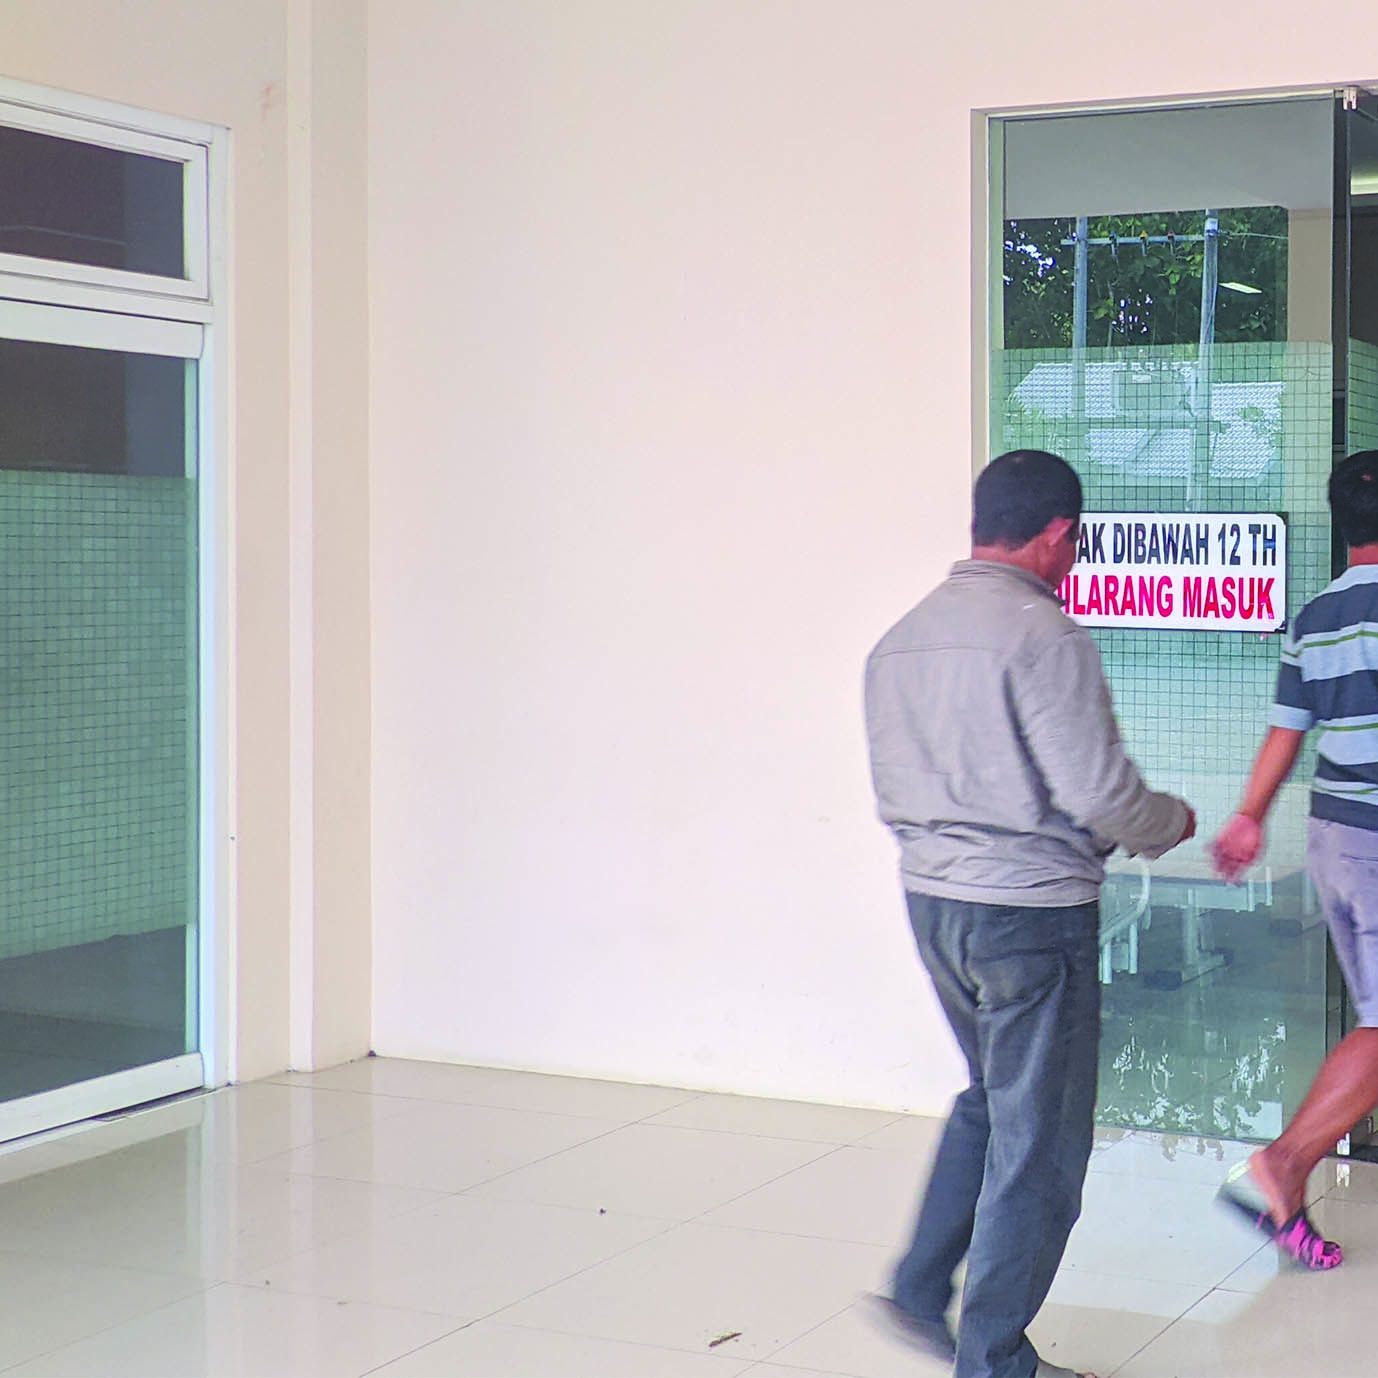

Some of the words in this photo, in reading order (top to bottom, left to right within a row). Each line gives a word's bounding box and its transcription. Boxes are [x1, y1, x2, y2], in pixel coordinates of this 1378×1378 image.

[1077, 523, 1106, 564] AK
[1113, 523, 1209, 565] DIBAWAH
[1218, 523, 1241, 566] 12
[1248, 524, 1277, 566] TH
[1058, 575, 1173, 618] ILARANG
[1183, 577, 1275, 620] MASUK
